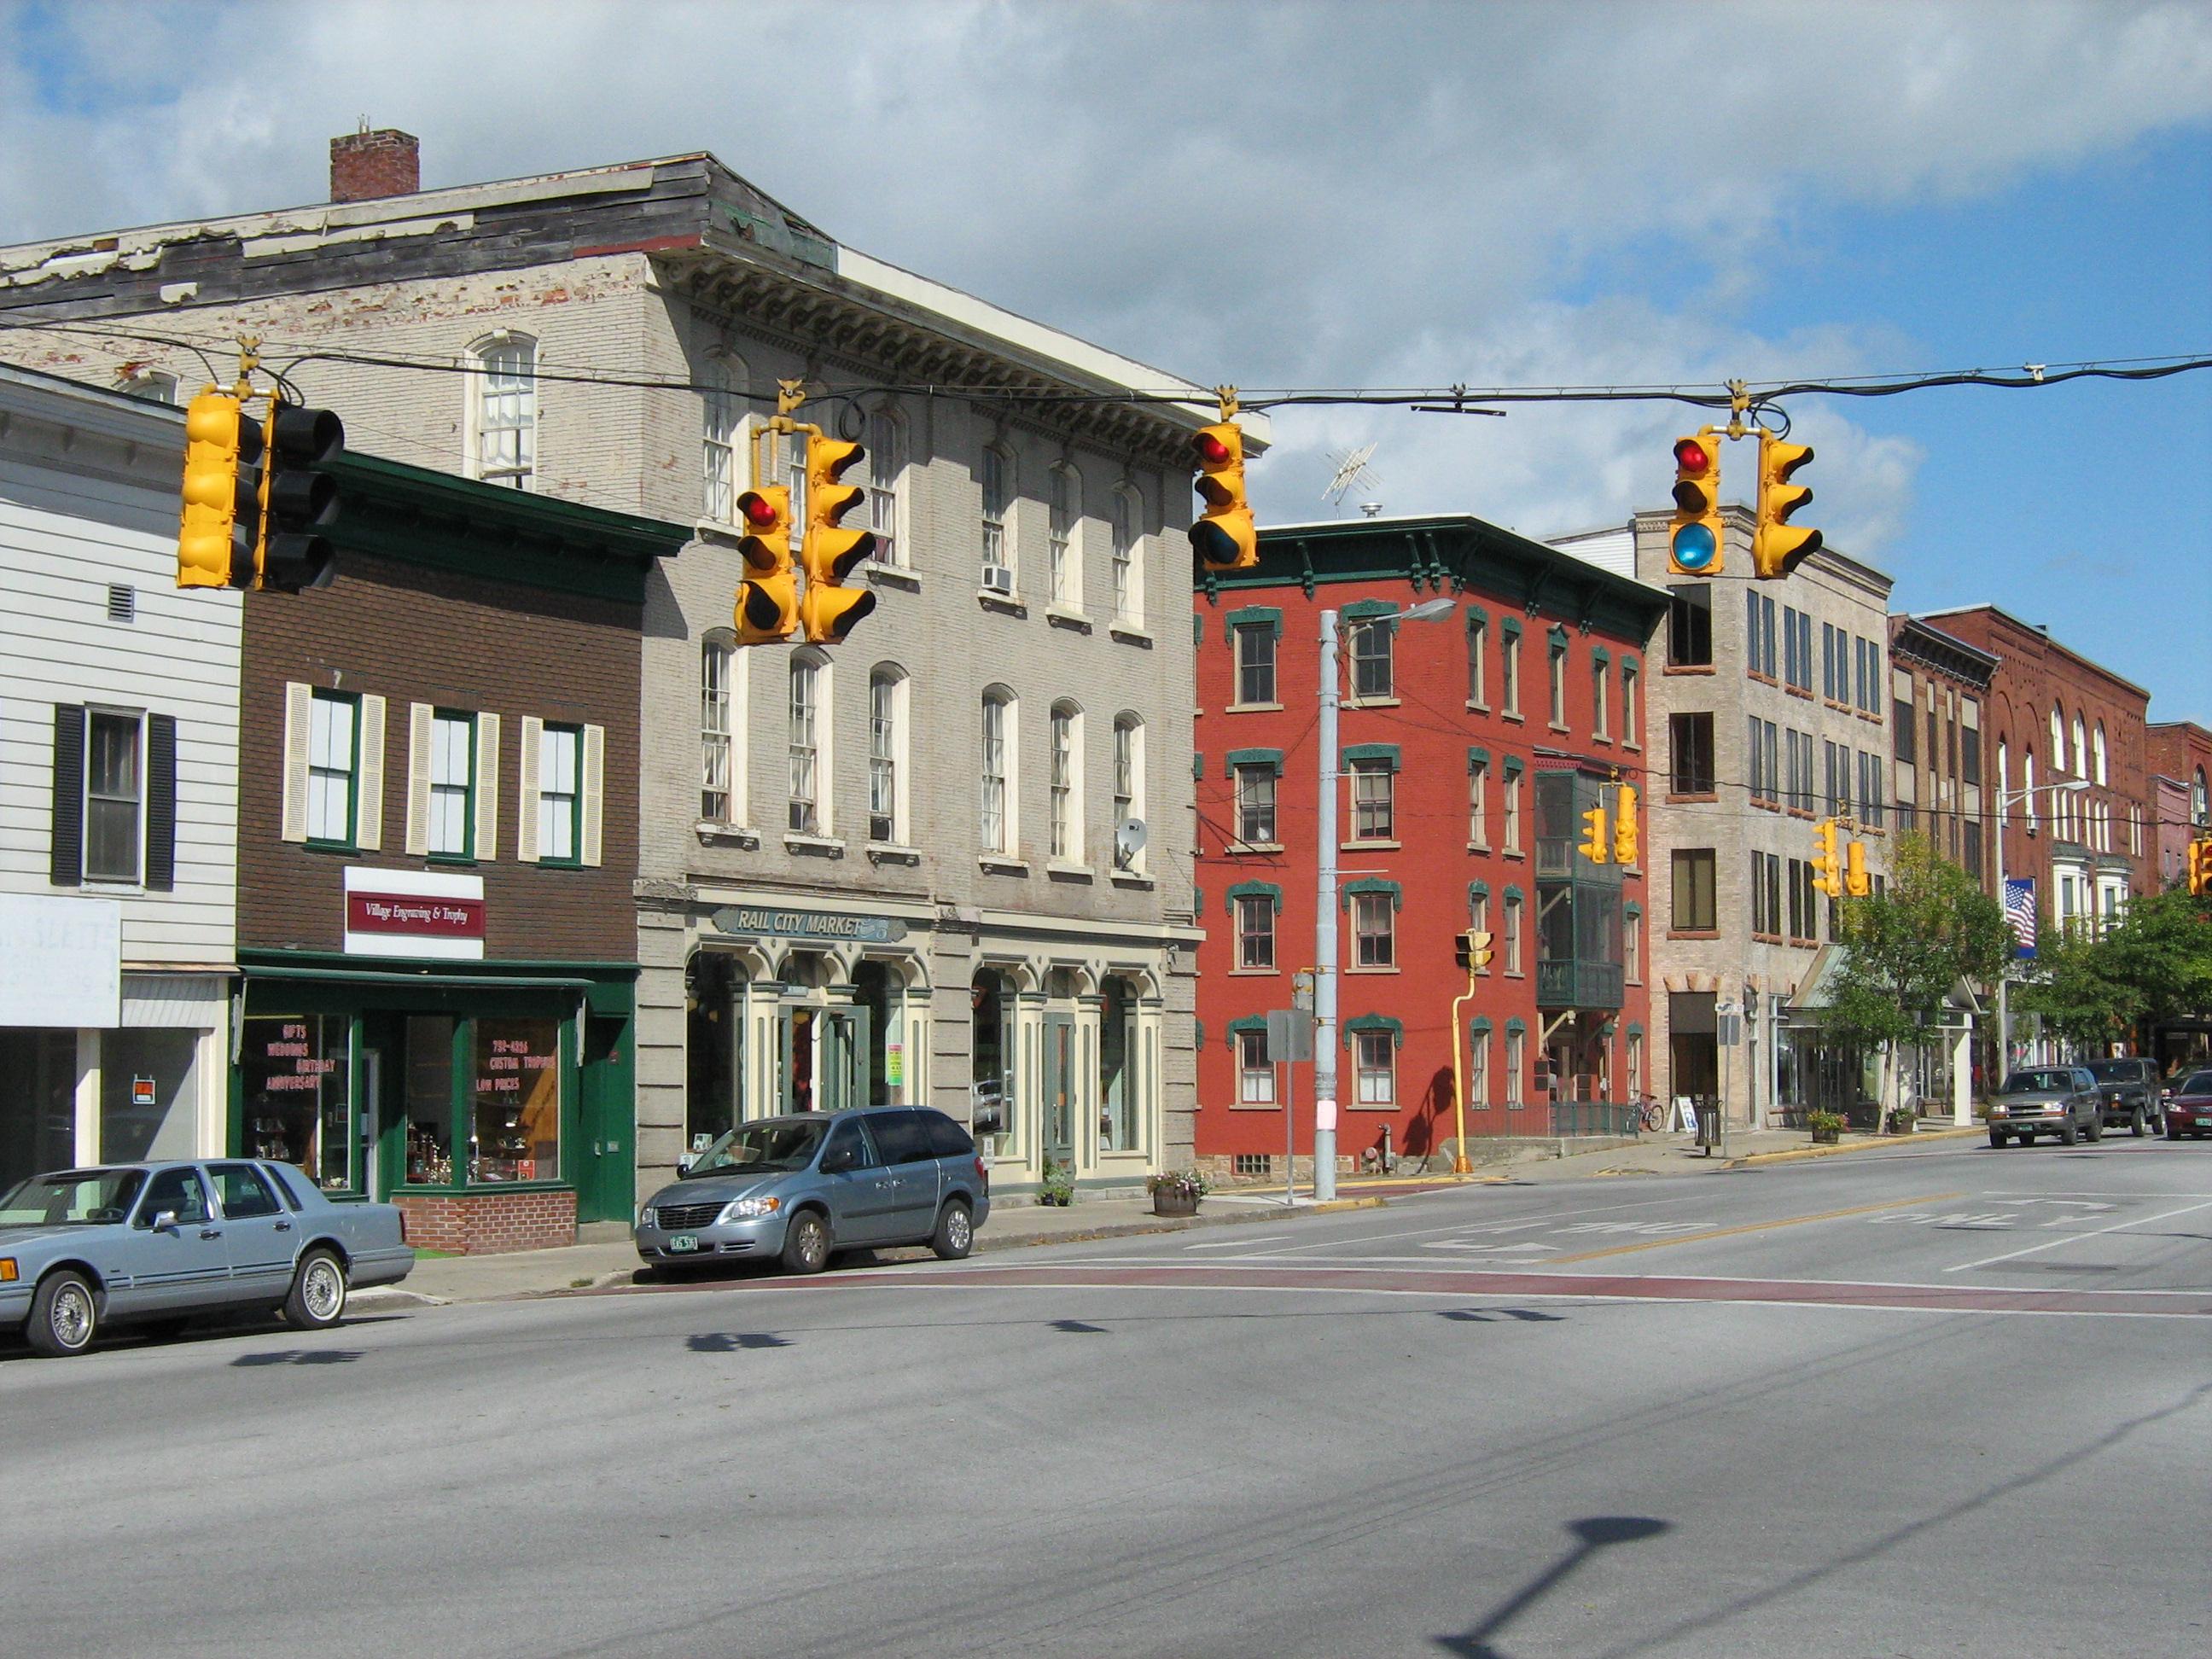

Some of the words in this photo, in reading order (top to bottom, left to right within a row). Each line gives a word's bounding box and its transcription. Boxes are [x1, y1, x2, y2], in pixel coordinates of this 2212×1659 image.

[365, 903, 391, 921] Village
[393, 905, 431, 923] Engraving
[433, 906, 440, 919] &
[443, 907, 468, 924] Trophy
[738, 911, 769, 928] RAIL
[774, 913, 805, 931] CITY
[806, 915, 861, 934] MARKET
[296, 1058, 335, 1073] BIRTHDAY
[490, 1057, 520, 1070] CUSTOM
[495, 1077, 519, 1091] PRICES
